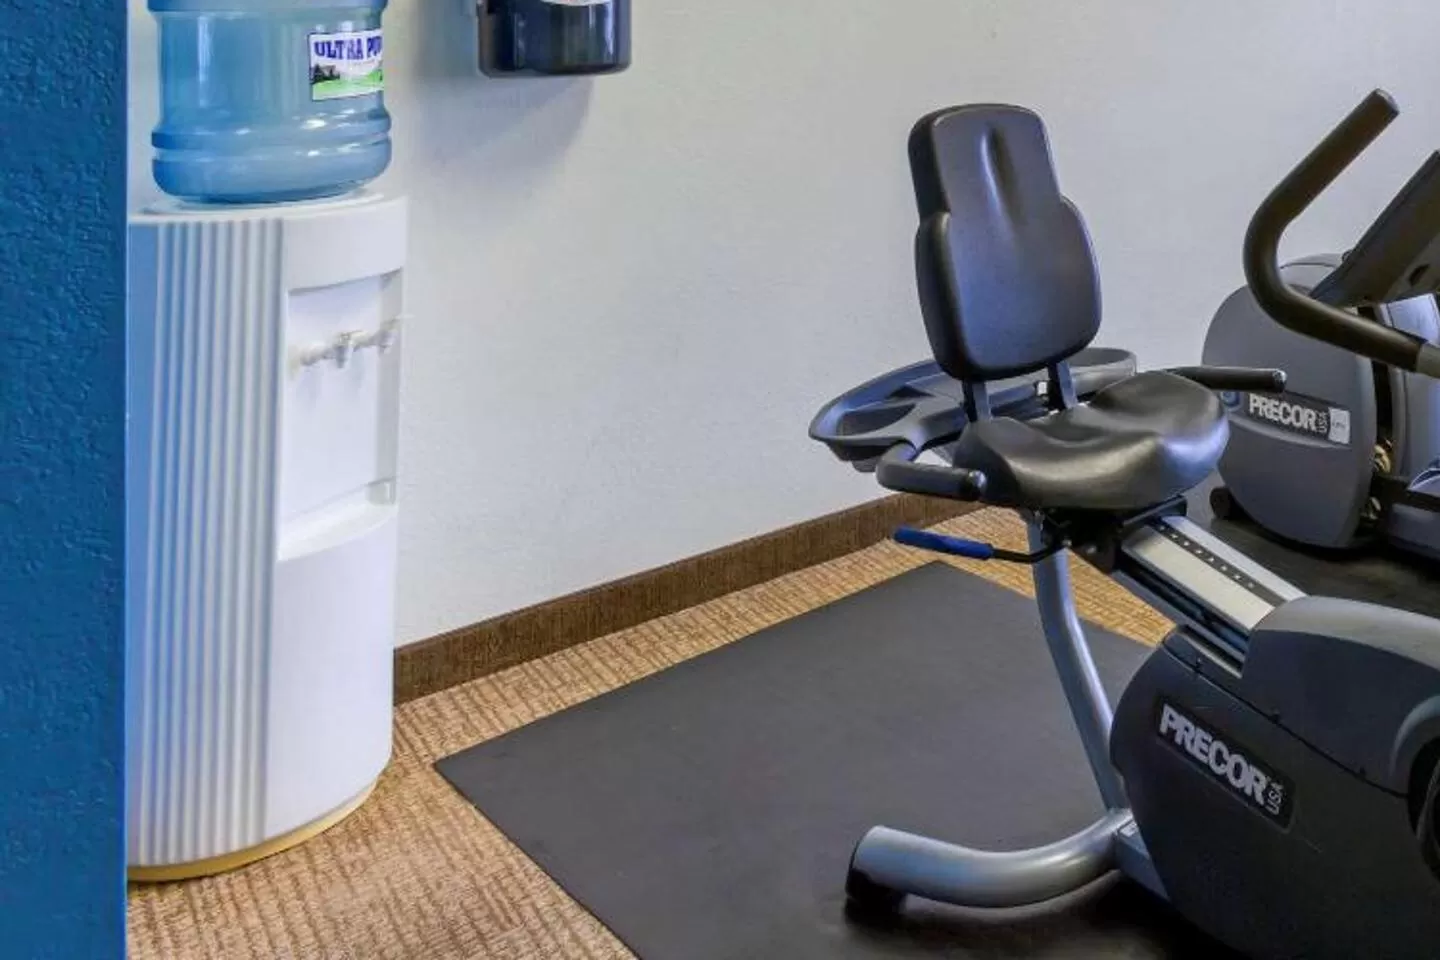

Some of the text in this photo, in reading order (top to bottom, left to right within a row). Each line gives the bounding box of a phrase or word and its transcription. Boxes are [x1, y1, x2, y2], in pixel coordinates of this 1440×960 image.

[314, 38, 363, 60] ULTRA
[1249, 392, 1317, 432] PRECOR
[1159, 703, 1283, 815] PRECOR USA
